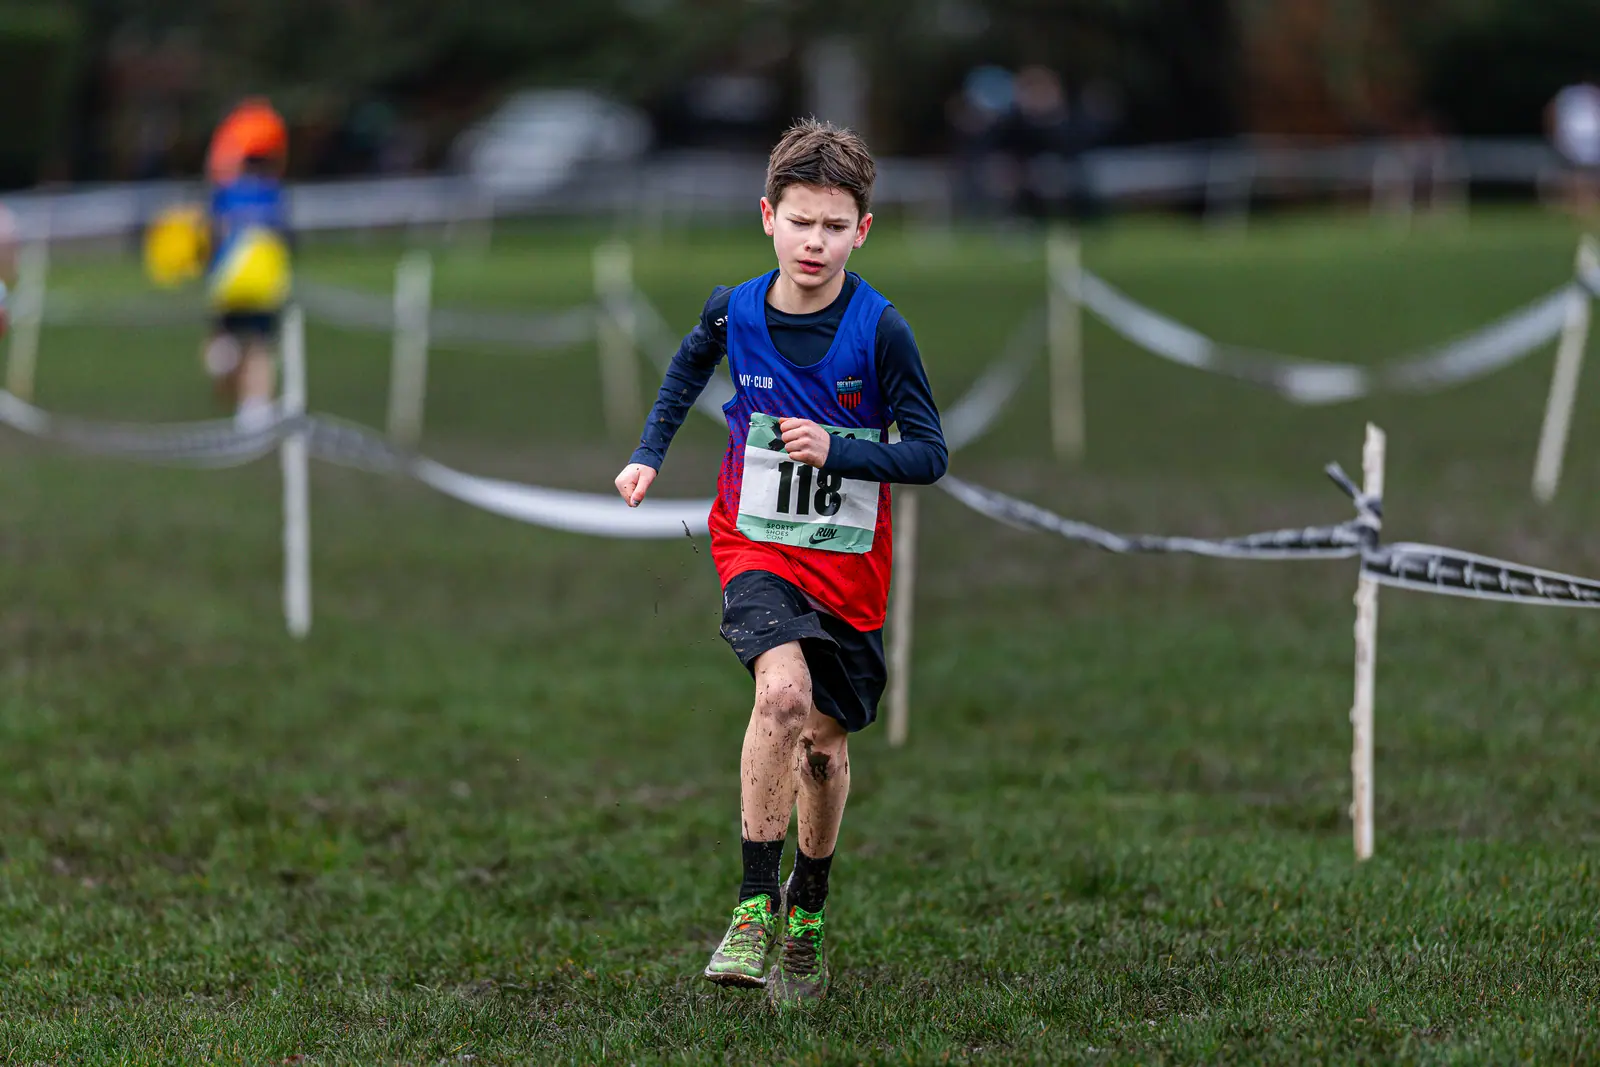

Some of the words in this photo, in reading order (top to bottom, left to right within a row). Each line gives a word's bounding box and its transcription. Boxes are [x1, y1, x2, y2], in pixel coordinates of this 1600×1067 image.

[776, 461, 842, 517] 118
[766, 523, 794, 532] SPORTS
[815, 527, 838, 537] RUN
[766, 529, 789, 537] SHOES
